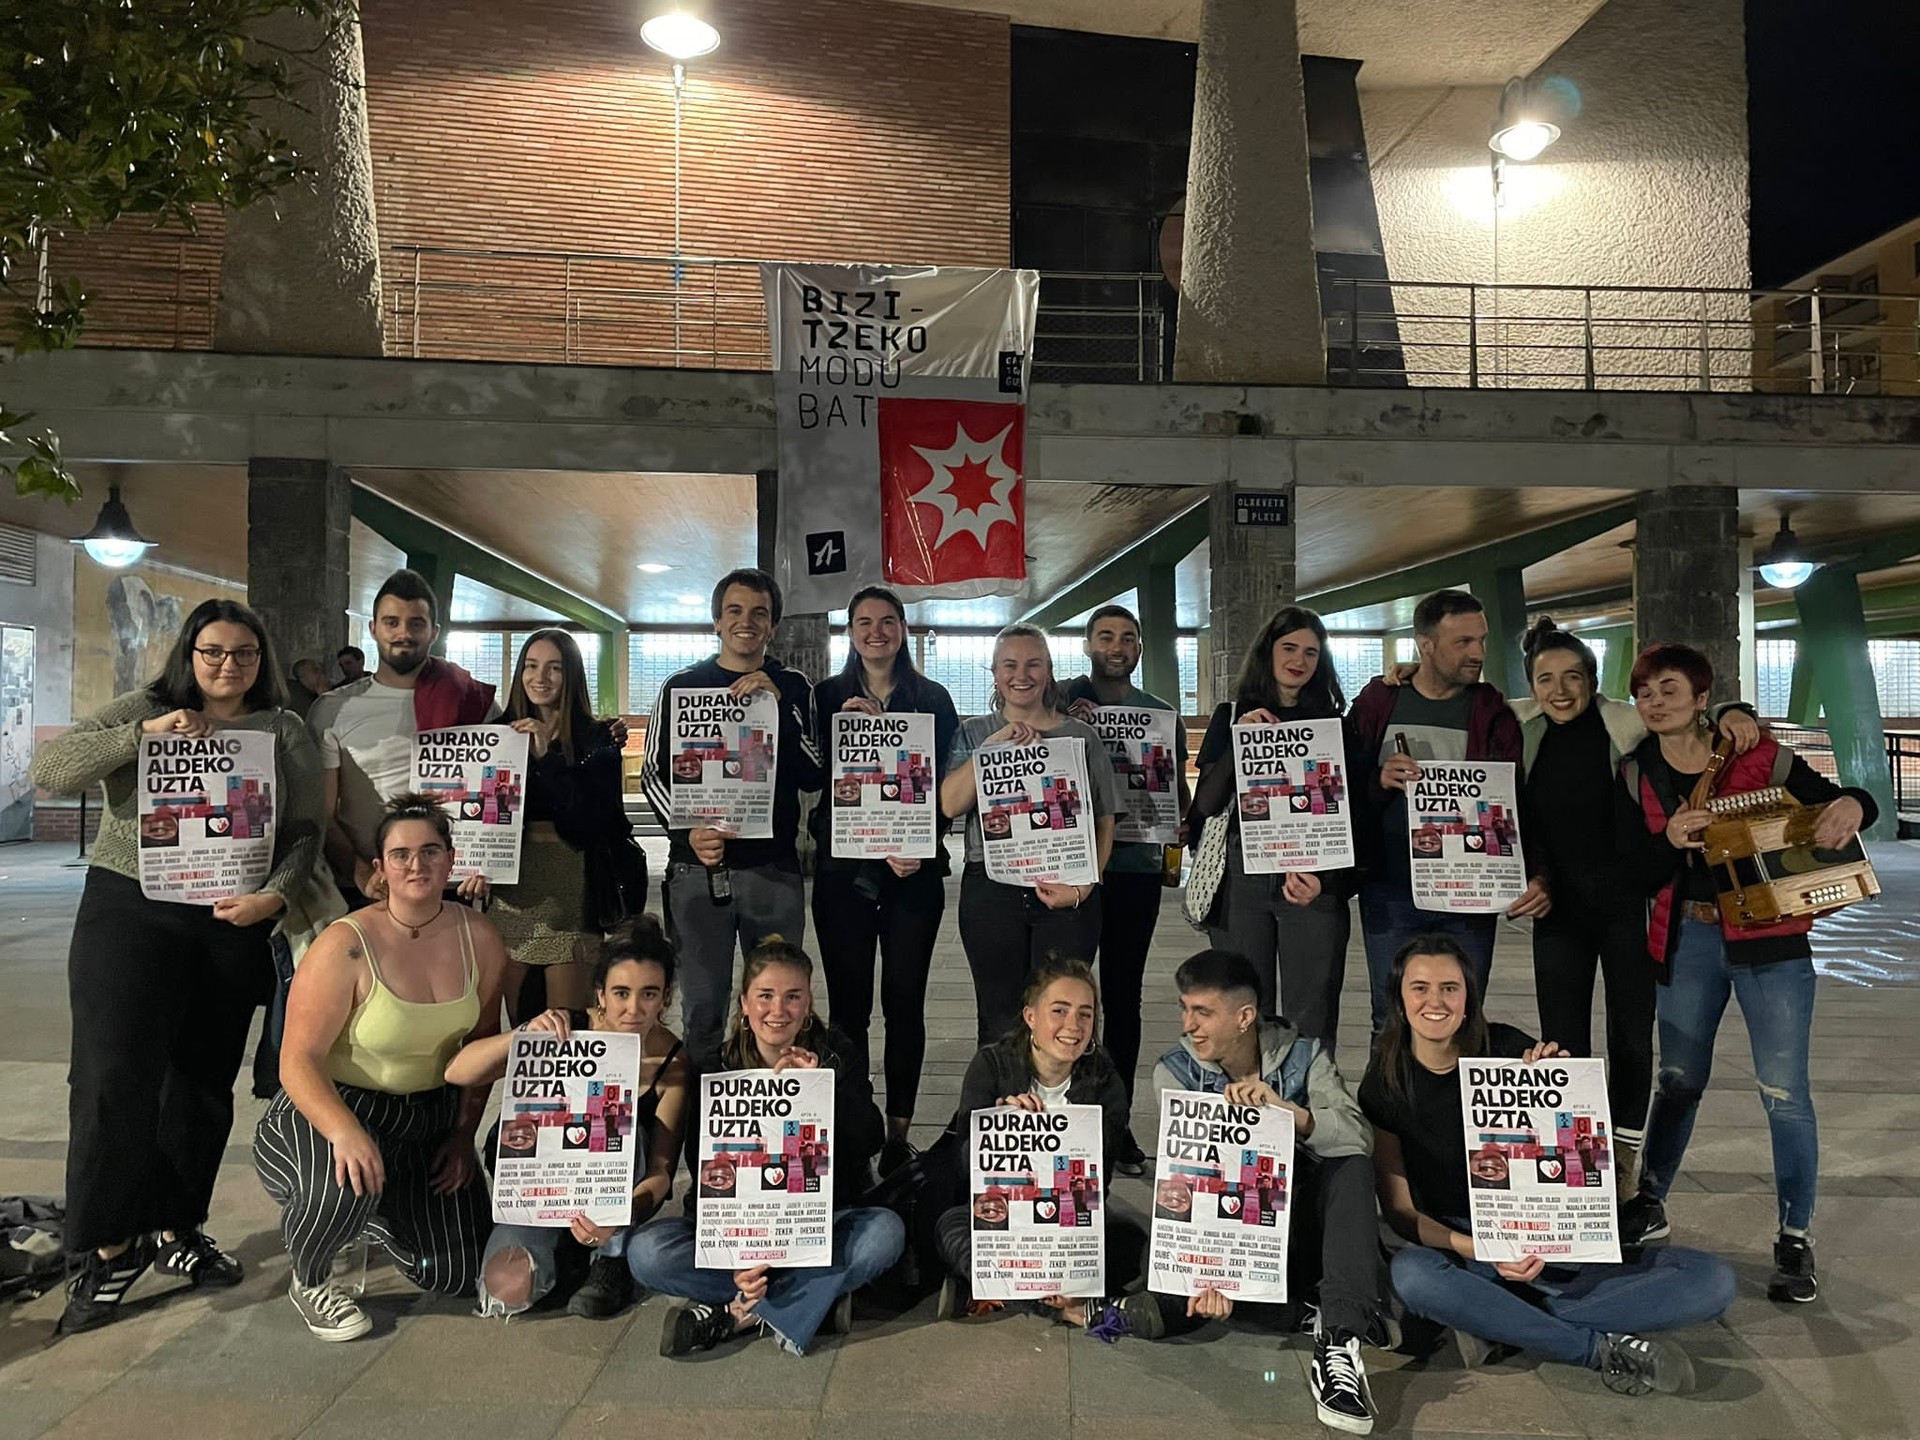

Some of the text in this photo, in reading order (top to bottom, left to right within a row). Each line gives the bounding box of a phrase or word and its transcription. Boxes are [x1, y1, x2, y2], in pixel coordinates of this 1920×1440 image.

[802, 284, 924, 321] BIZI-
[802, 319, 928, 354] TZEKO
[800, 355, 901, 389] MODU
[799, 395, 874, 429] BAT
[678, 693, 752, 709] DURANG
[678, 708, 745, 723] ALDEKO
[678, 724, 722, 737] UZTA
[839, 719, 908, 732] DURANG
[1098, 727, 1146, 739] LDEKO
[419, 732, 499, 746] DURANG
[838, 734, 903, 747] ALDEKO
[1240, 728, 1313, 745] DURANG
[148, 739, 242, 757] DURANG
[418, 747, 490, 762] ALDEKO
[838, 749, 880, 762] UZTA
[979, 746, 1049, 768] DURANG
[1241, 744, 1308, 760] ALDEKO
[147, 757, 234, 775] ALDEKO
[418, 764, 464, 778] UZTA
[982, 761, 1045, 782] ALDEKO
[1242, 760, 1286, 775] UZTA
[147, 776, 205, 794] UZTA
[983, 779, 1025, 796] UZTA
[1415, 783, 1481, 797] ALDEKO
[1415, 798, 1461, 811] UZTA
[516, 1040, 606, 1057] DURANG
[513, 1060, 597, 1078] ALDEKO
[1469, 1068, 1569, 1087] DURANG
[512, 1080, 566, 1098] UZTA
[709, 1079, 800, 1097] DURANG
[1471, 1089, 1562, 1108] ALDEKO
[709, 1099, 792, 1117] ALDEKO
[1170, 1098, 1260, 1125] DURANG
[979, 1114, 1069, 1132] DURANG
[1473, 1110, 1533, 1128] UZTA
[709, 1120, 762, 1137] UZTA
[1167, 1120, 1250, 1145] ALDEKO
[979, 1134, 1061, 1152] ALDEKO
[1166, 1140, 1220, 1163] UZTA
[979, 1154, 1032, 1172] UZTA
[574, 1186, 592, 1194] ZEKER
[775, 1227, 792, 1235] ZEKER
[1228, 1257, 1246, 1267] ZEKER
